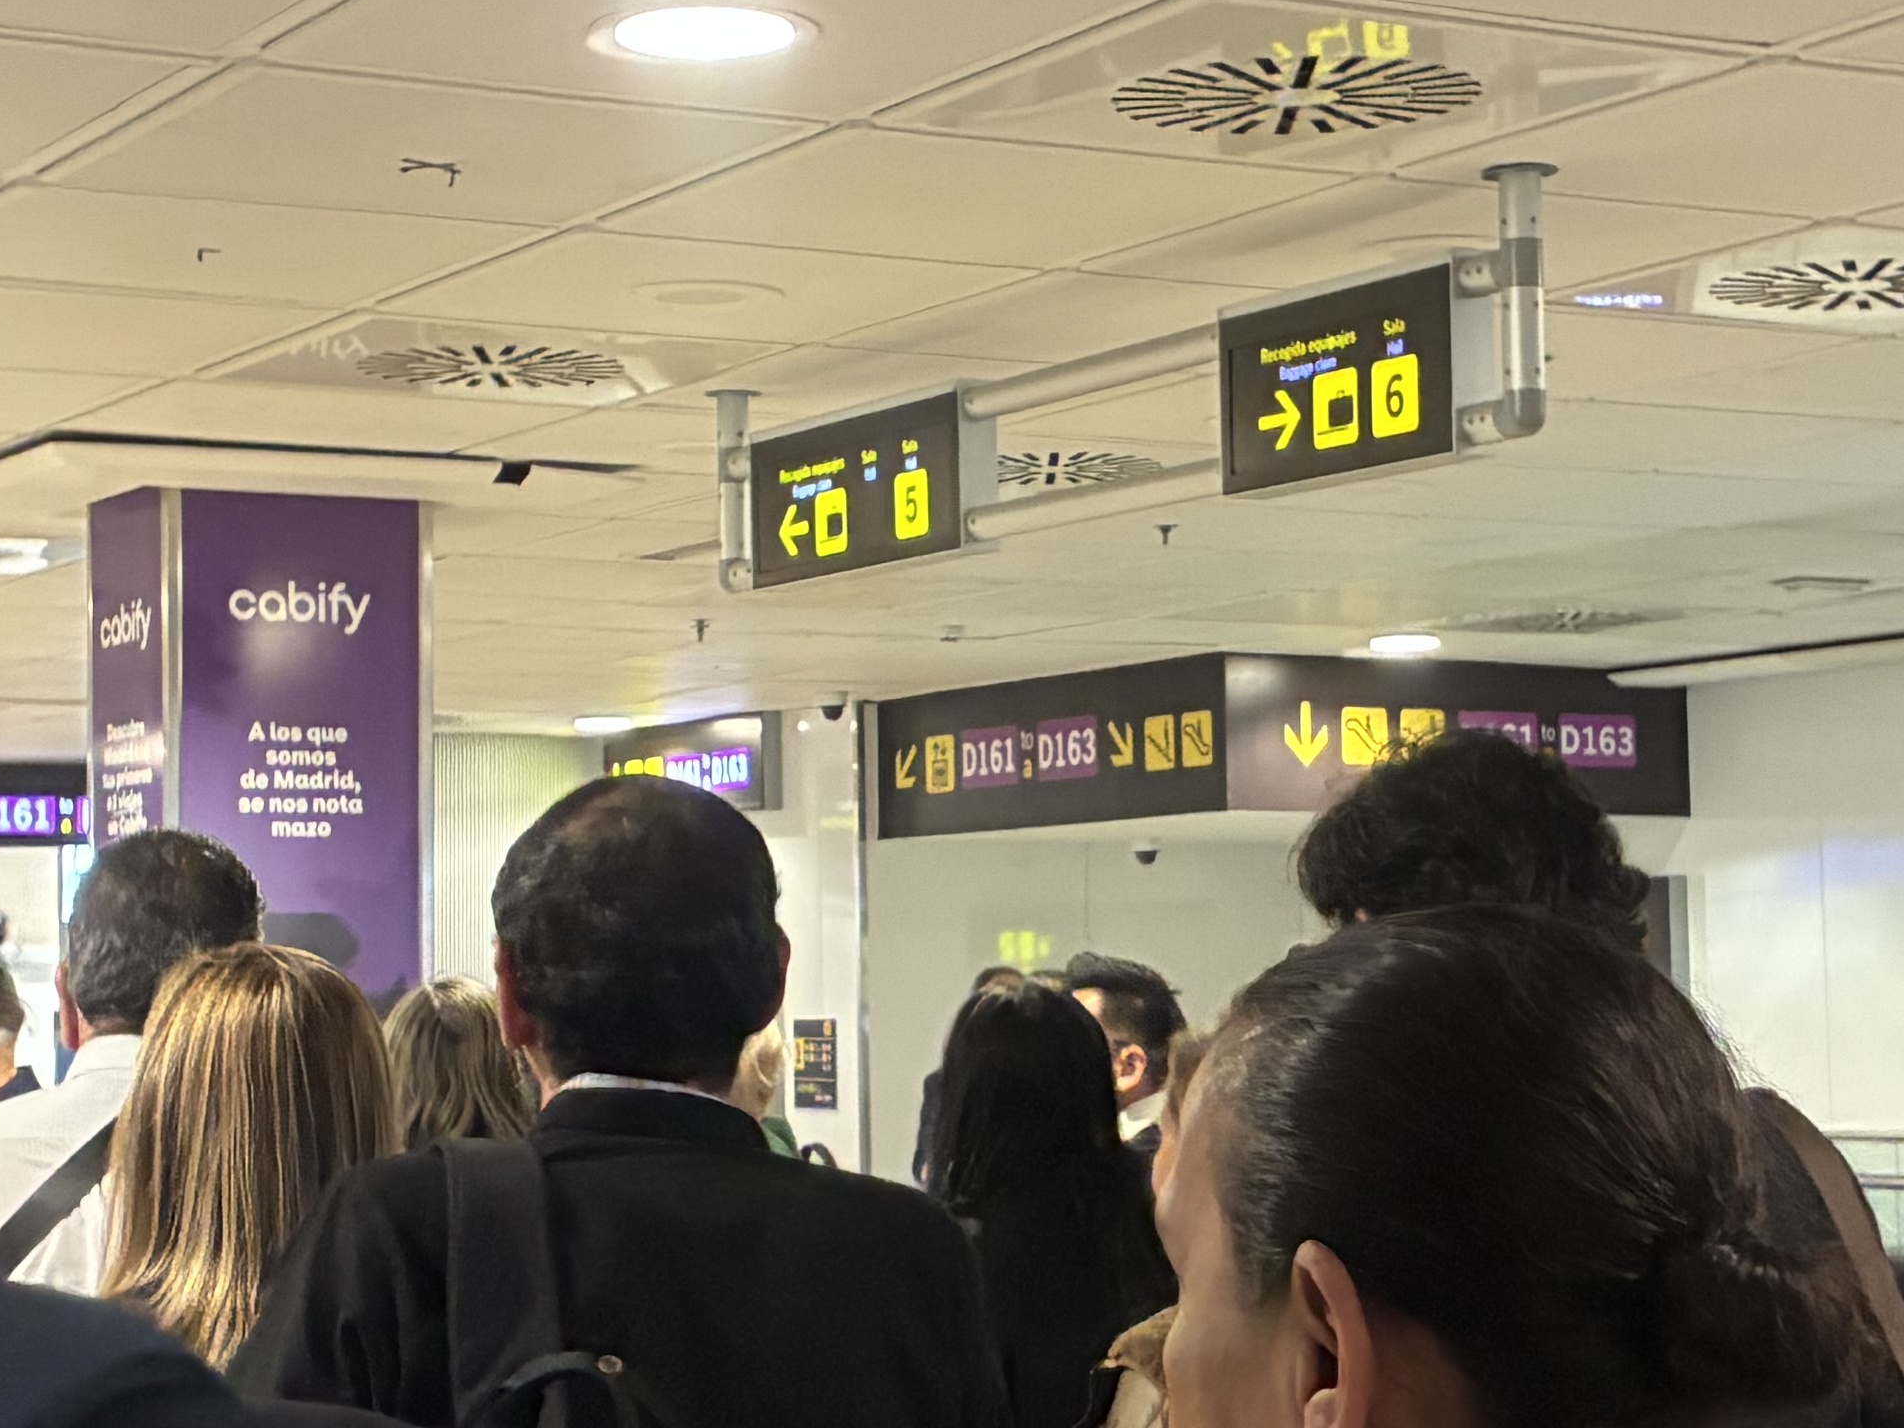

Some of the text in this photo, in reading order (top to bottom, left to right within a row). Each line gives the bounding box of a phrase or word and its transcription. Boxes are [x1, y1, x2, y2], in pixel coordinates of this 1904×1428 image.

[1385, 373, 1404, 418] 6
[905, 485, 918, 523] 5
[229, 581, 370, 635] cabify
[100, 598, 151, 650] cabify
[248, 720, 348, 747] A los que
[1021, 730, 1034, 750] to
[1541, 724, 1556, 742] to
[1561, 725, 1633, 756] D163
[265, 749, 337, 766] somos
[962, 727, 1096, 777] D161 D163
[240, 768, 362, 795] de Madrid,
[1023, 758, 1033, 779] a
[269, 797, 308, 814] nos
[312, 795, 364, 814] nota
[271, 821, 331, 838] mazo
